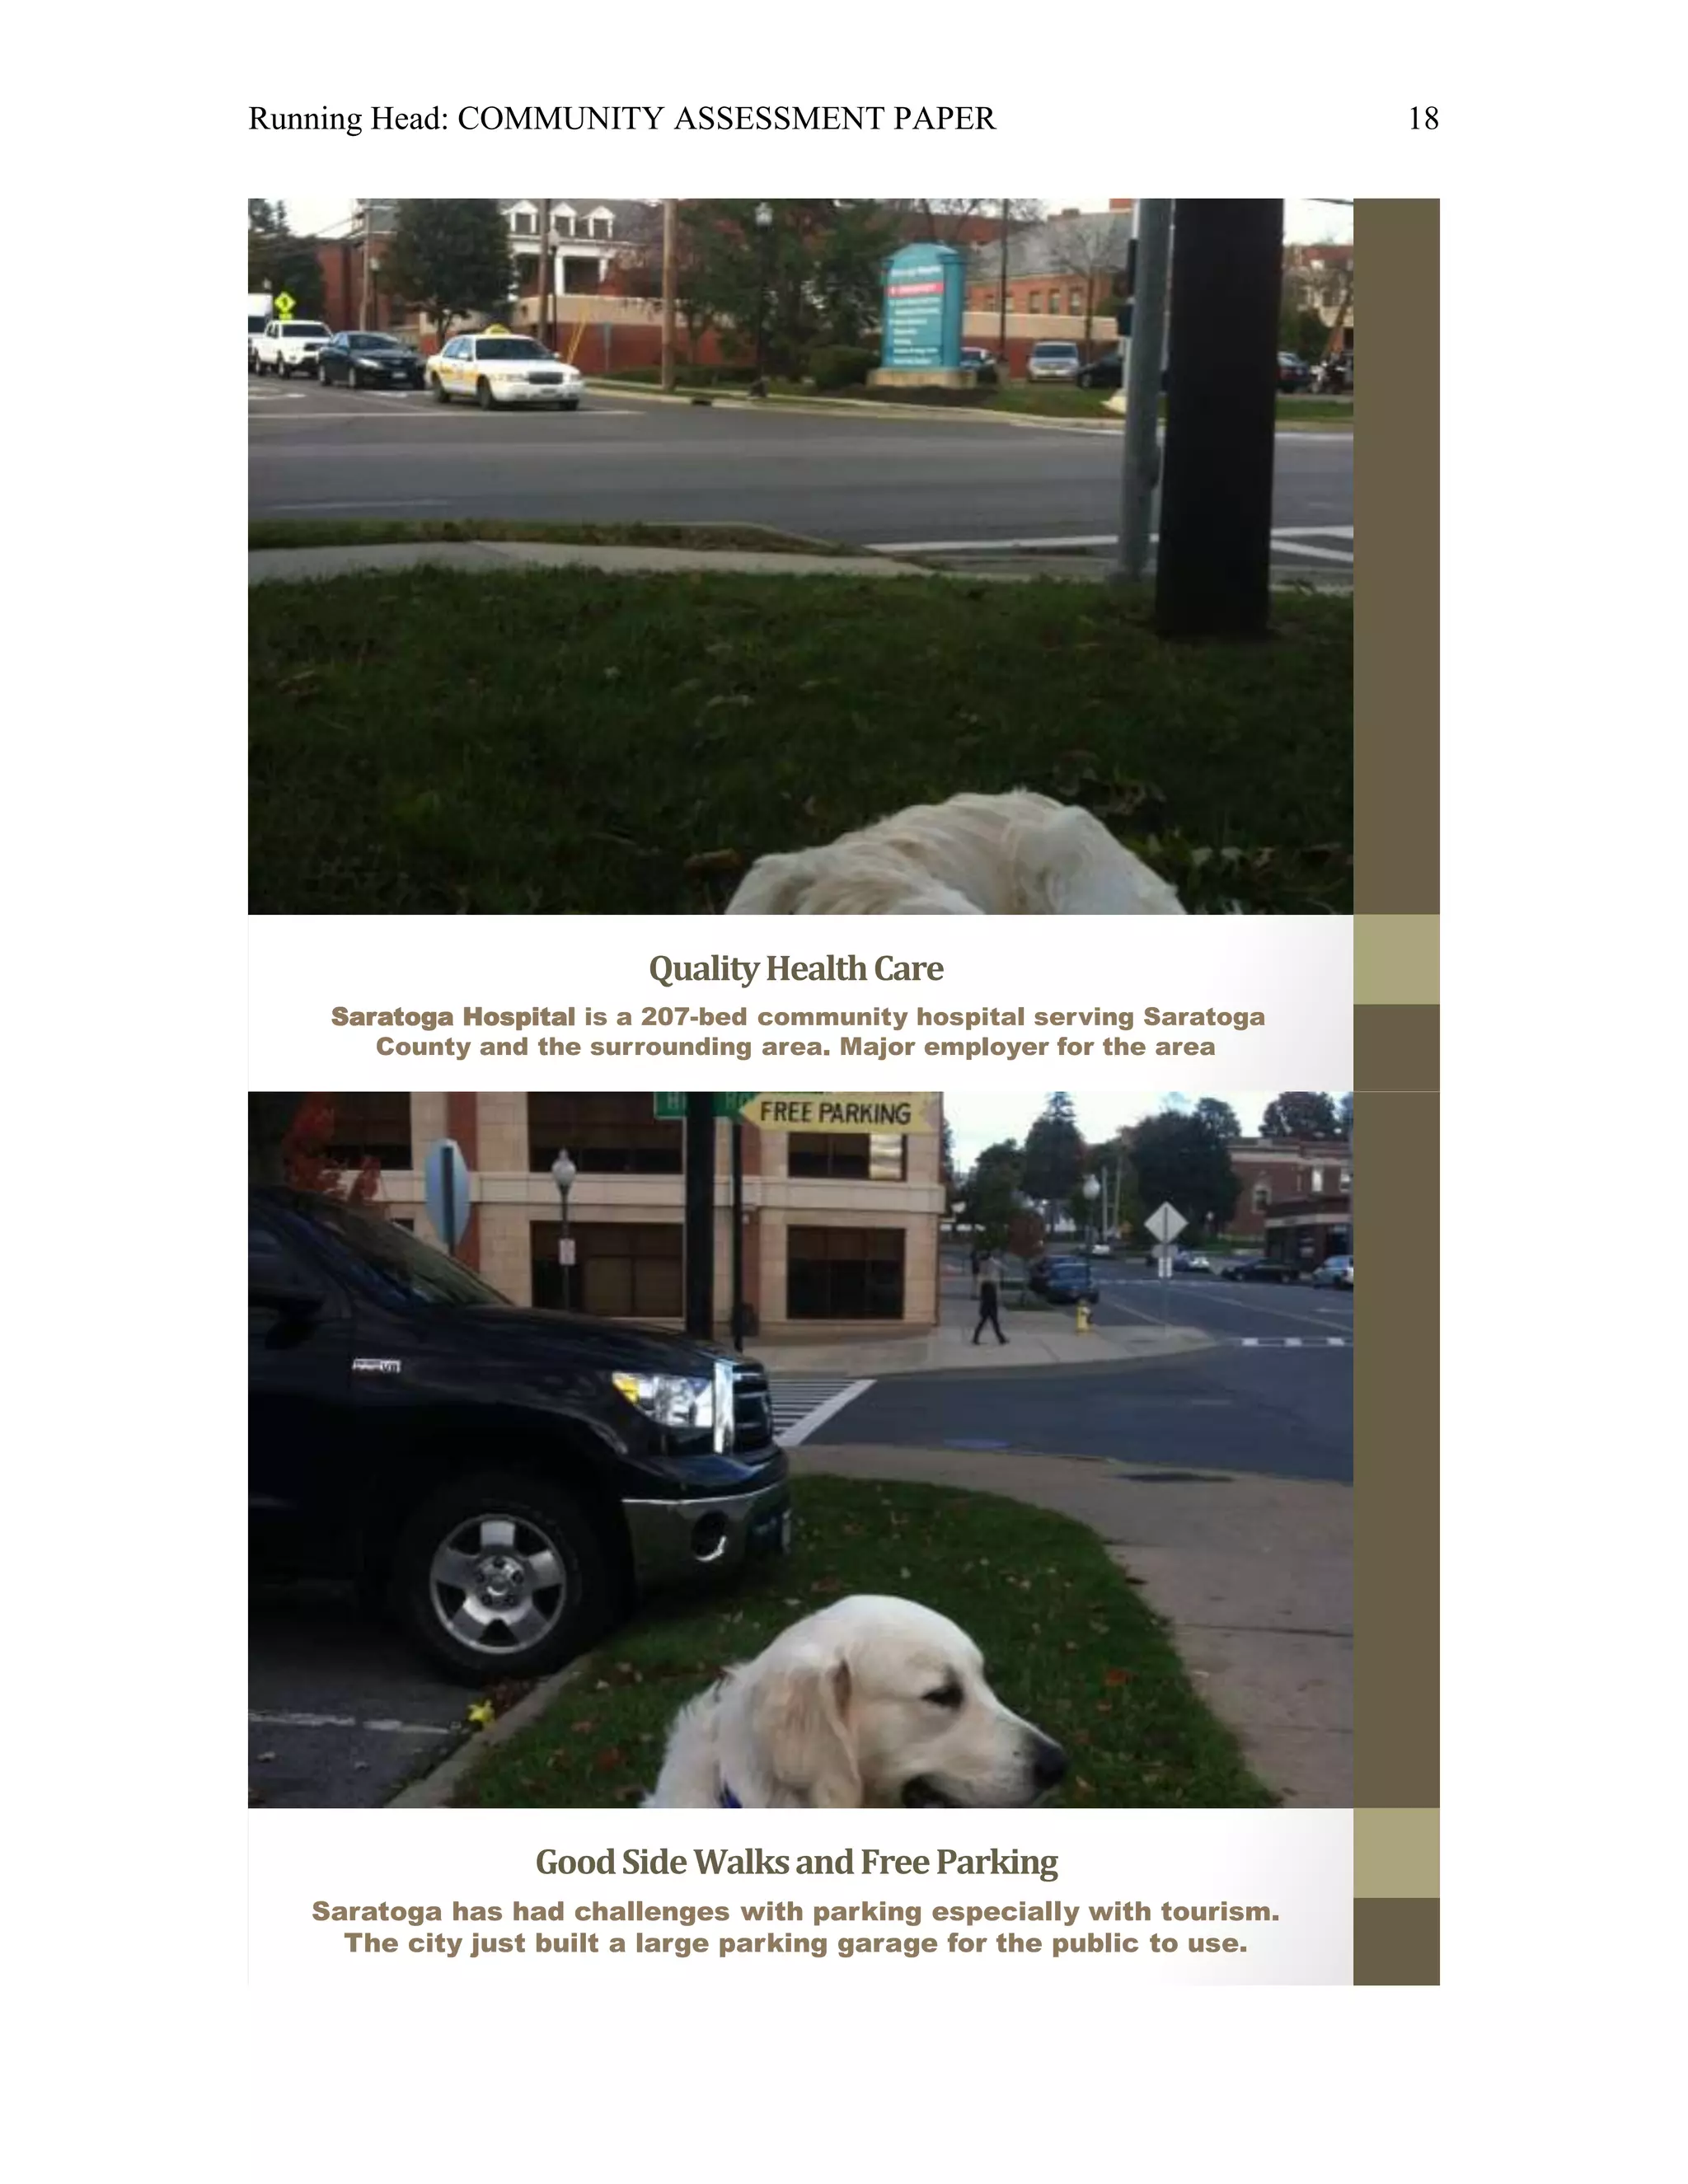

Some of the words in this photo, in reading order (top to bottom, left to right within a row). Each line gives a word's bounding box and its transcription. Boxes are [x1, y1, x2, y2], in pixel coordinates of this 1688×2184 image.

[248, 105, 363, 137] Running
[370, 105, 448, 130] Head:
[458, 105, 665, 130] COMMUNITY
[673, 105, 885, 130] ASSESSMENT
[893, 105, 997, 130] PAPER
[1410, 105, 1439, 130] 18
[760, 1101, 813, 1123] FREE
[818, 1102, 912, 1126] PARKING
